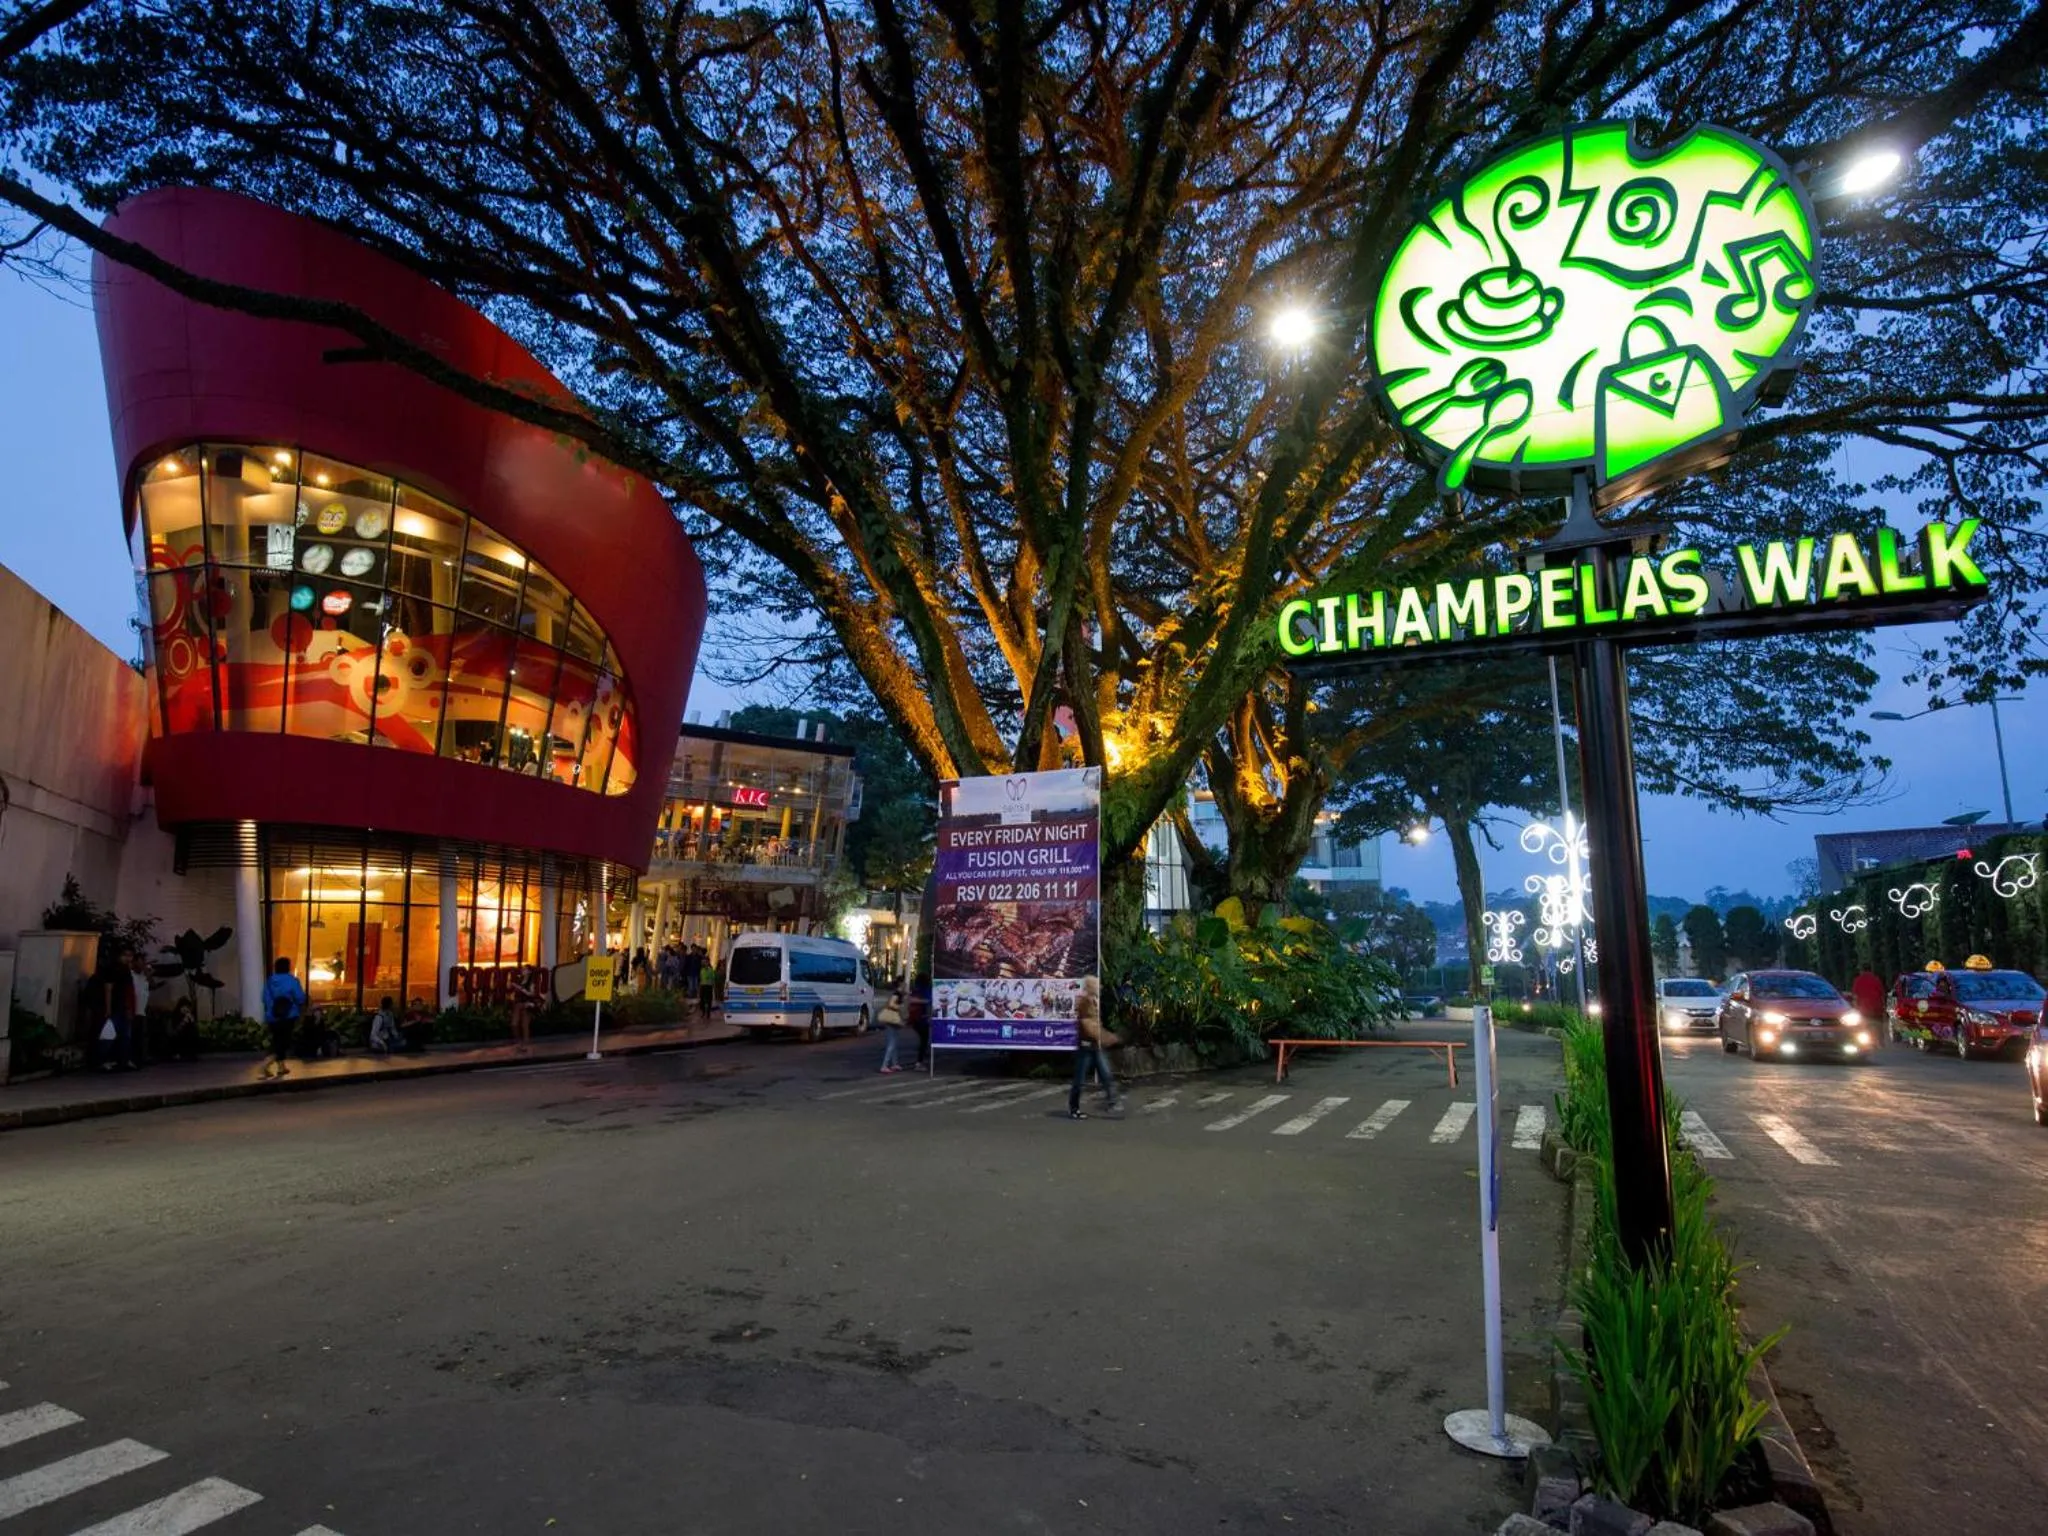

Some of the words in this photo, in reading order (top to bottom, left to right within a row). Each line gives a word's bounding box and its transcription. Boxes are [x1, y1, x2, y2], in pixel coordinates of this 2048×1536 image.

[1277, 549, 1710, 656] CIHAMPELAS
[1738, 518, 1989, 606] WALK
[951, 830, 992, 847] EVERY
[994, 827, 1042, 844] FRIDAY
[1045, 824, 1088, 841] NIGHT
[968, 850, 1025, 868] FUSION
[1028, 847, 1072, 865] GRILL
[945, 872, 957, 880] ALL
[958, 872, 972, 880] YOU
[973, 870, 986, 879] CAN
[988, 870, 1000, 878] EAT
[1030, 868, 1046, 876] ONLY
[957, 884, 985, 902] RSV
[988, 883, 1012, 900] 022
[1015, 882, 1040, 899] 206
[1044, 881, 1058, 898] 11
[1063, 880, 1078, 897] 11
[589, 968, 611, 978] DROP
[591, 979, 607, 988] OFF
